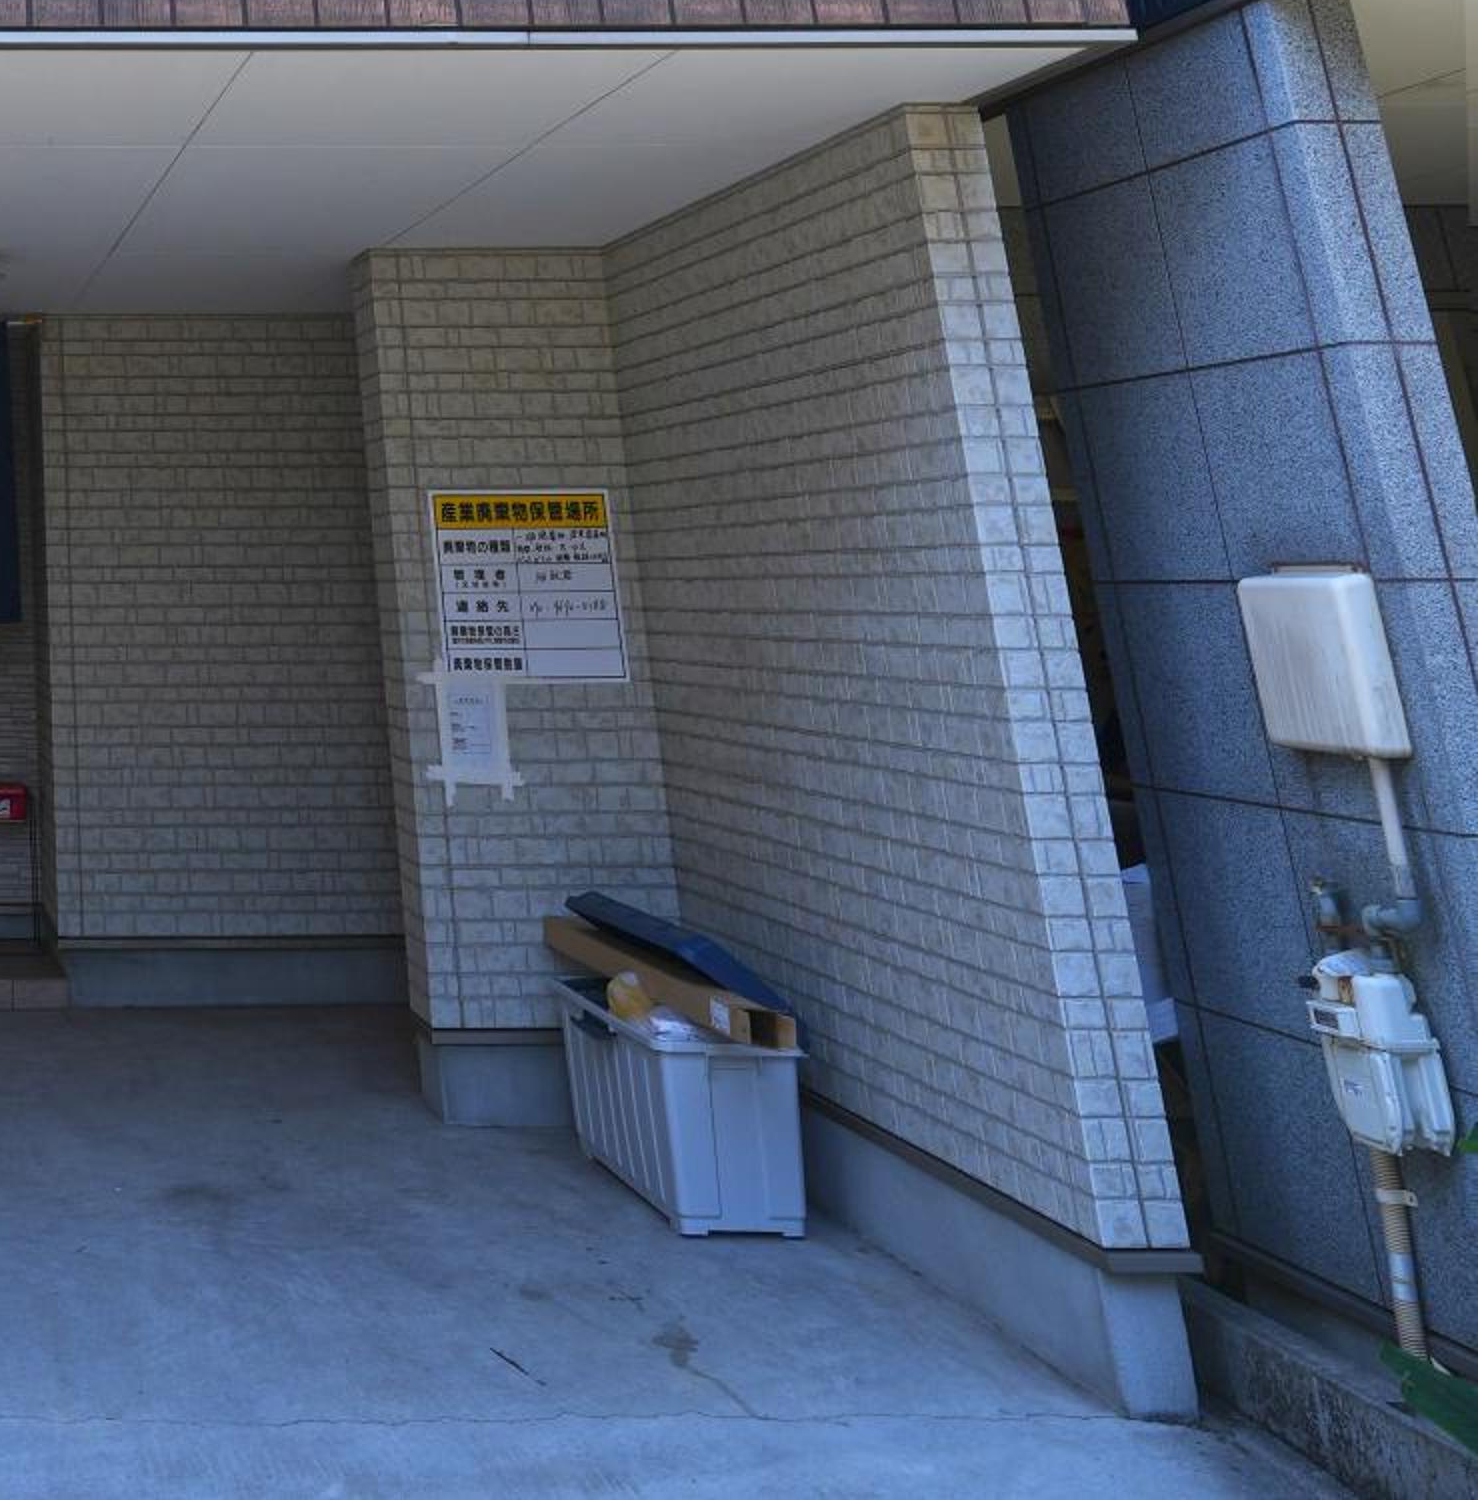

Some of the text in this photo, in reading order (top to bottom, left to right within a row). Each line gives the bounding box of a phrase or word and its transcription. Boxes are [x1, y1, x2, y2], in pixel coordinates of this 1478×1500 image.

[441, 501, 599, 522] 産業廃棄物保管場所
